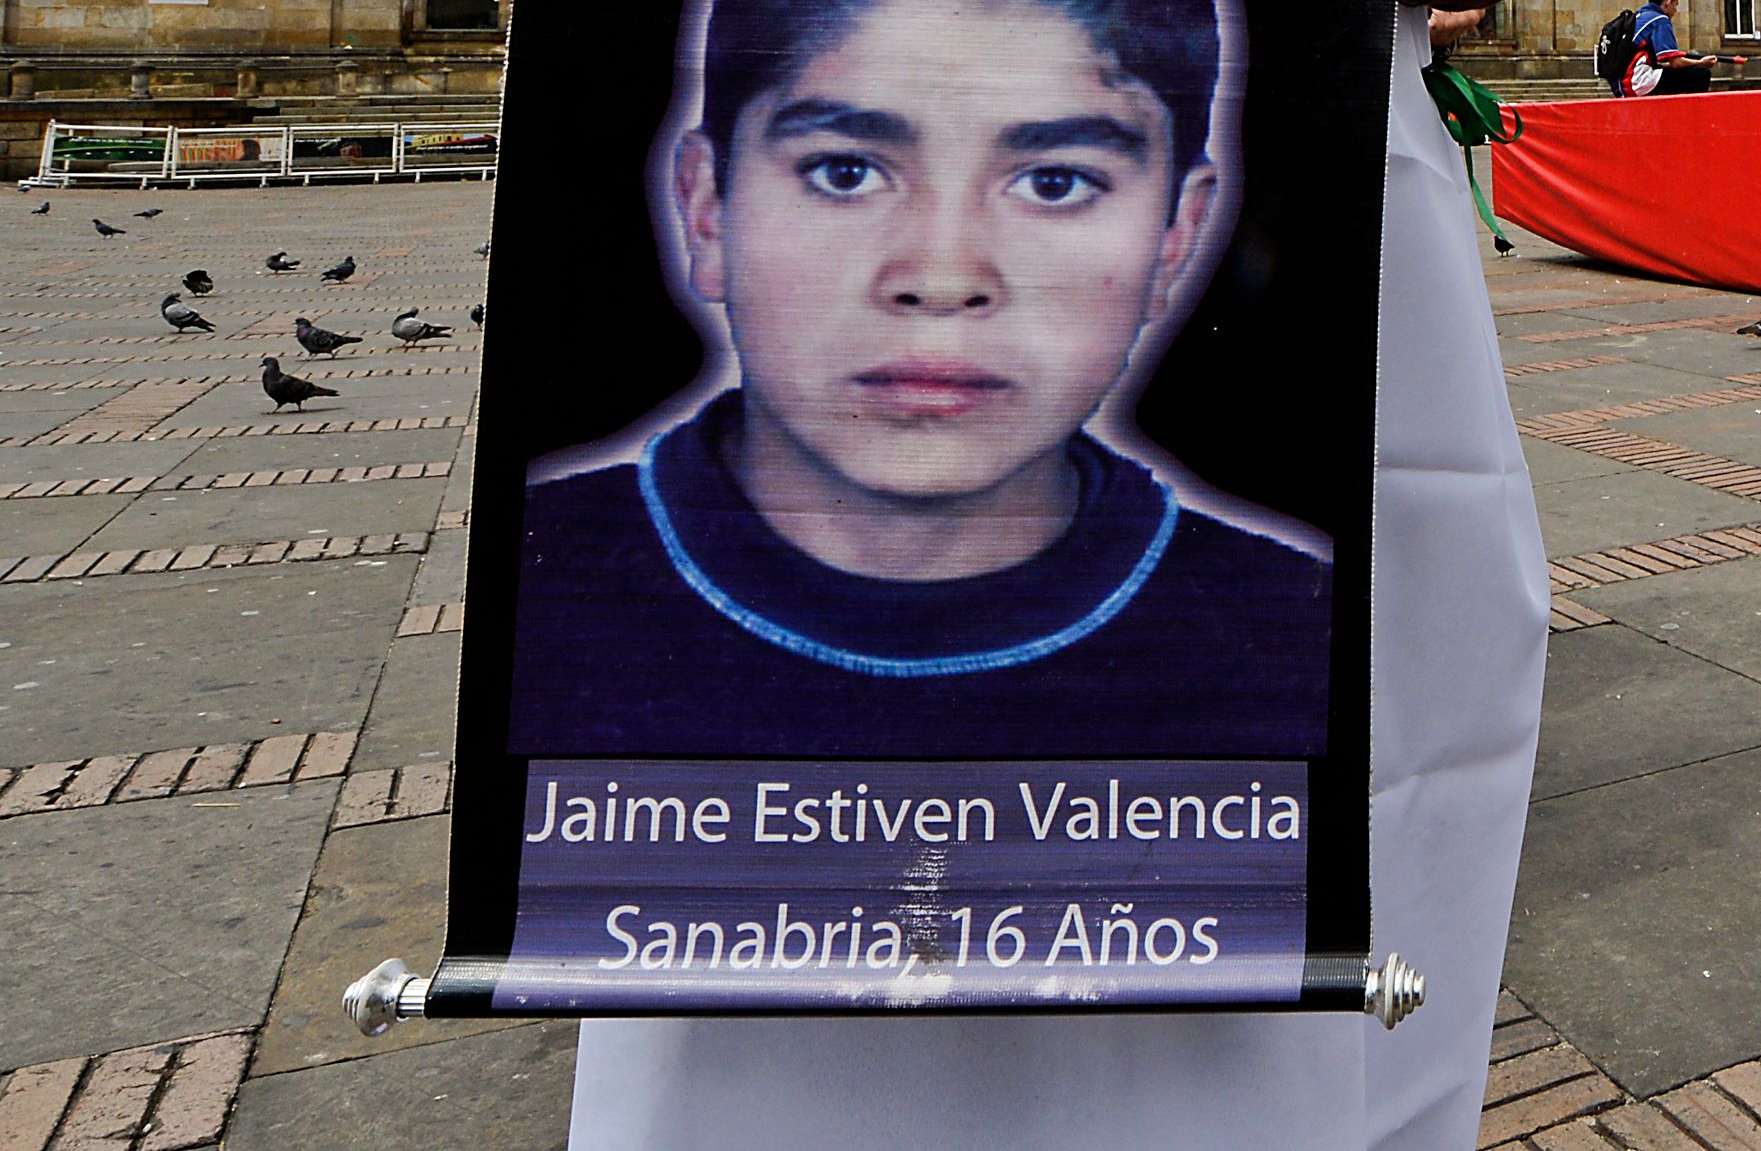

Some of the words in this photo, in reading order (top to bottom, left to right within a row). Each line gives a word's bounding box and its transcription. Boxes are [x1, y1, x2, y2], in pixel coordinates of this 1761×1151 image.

[526, 781, 731, 843] Jaime
[754, 782, 995, 843] Estiven
[1018, 779, 1300, 841] Valencia
[598, 903, 920, 980] Sanabria,
[950, 905, 1027, 968] 16
[1044, 902, 1219, 967] Años
